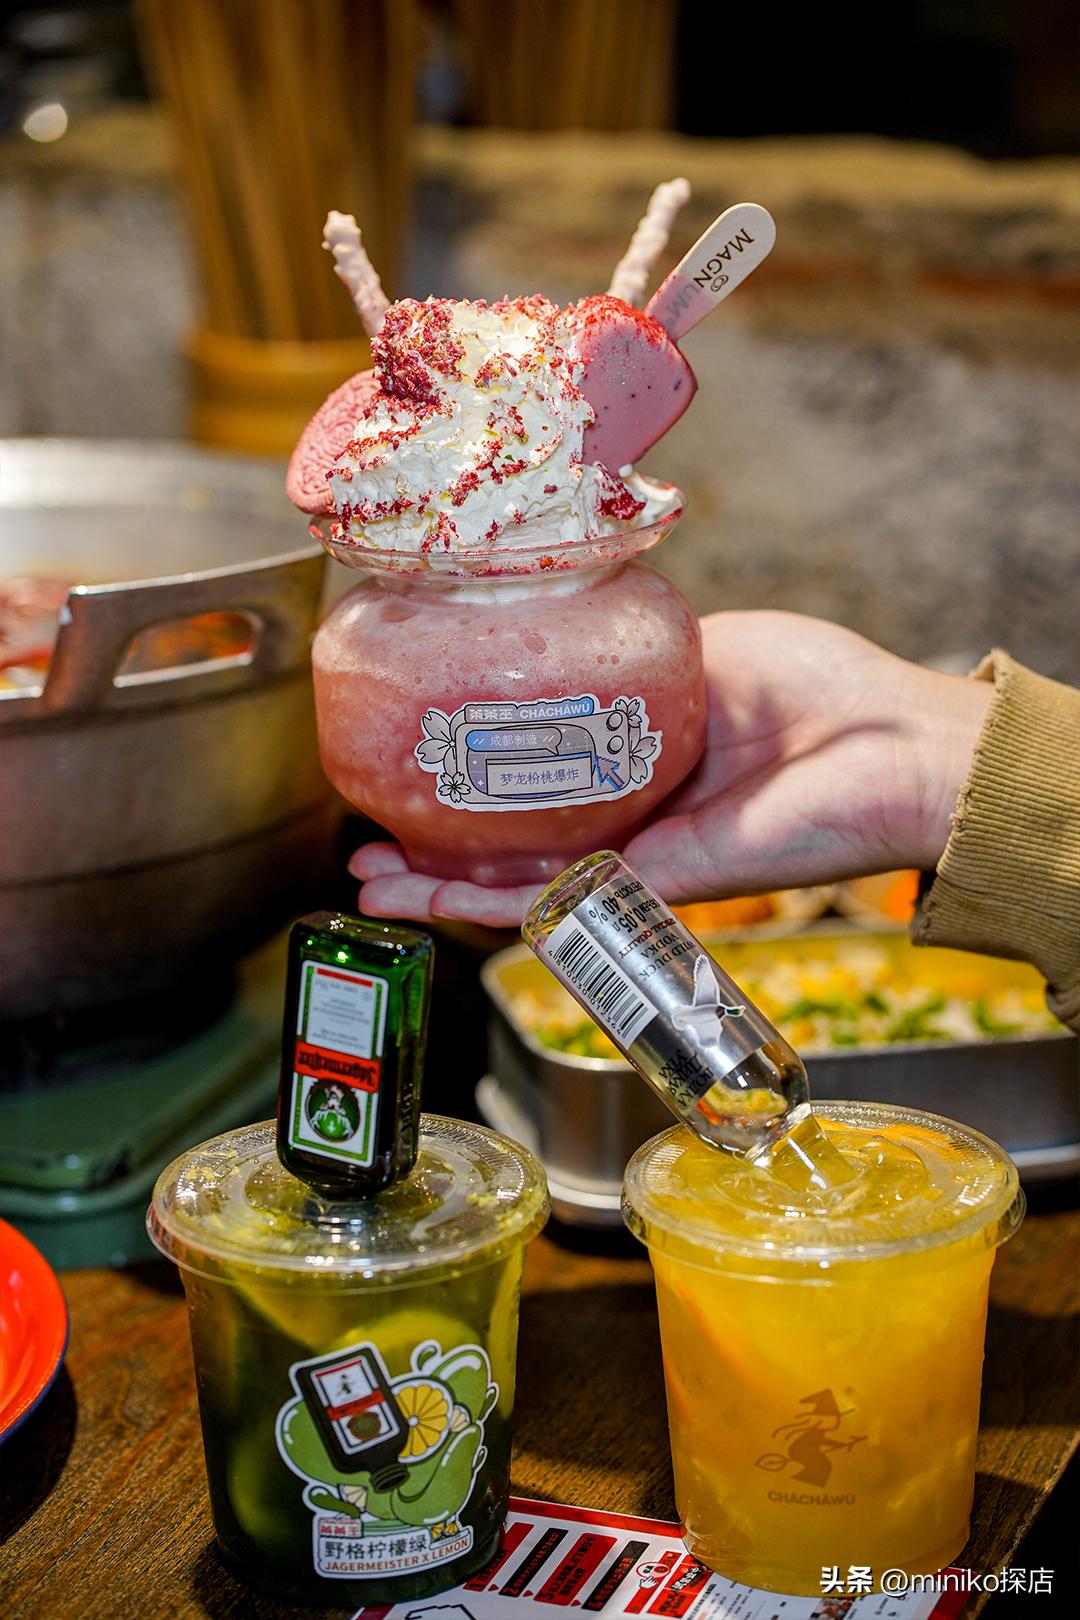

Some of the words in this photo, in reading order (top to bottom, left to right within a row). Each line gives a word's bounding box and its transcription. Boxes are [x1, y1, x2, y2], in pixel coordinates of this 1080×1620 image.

[491, 734, 537, 746] 成都制造
[500, 767, 579, 787] 梦龙粉桃爆炸
[589, 906, 608, 925] %
[601, 896, 620, 915] 40
[618, 905, 646, 933] 0,05
[618, 929, 653, 959] QUALITY
[640, 933, 679, 958] VODKA
[671, 941, 697, 956] WILD
[639, 953, 673, 978] DUCK
[325, 1534, 427, 1560] 野格柠檬绿
[422, 1554, 429, 1564] X
[432, 1538, 468, 1560] LEMON
